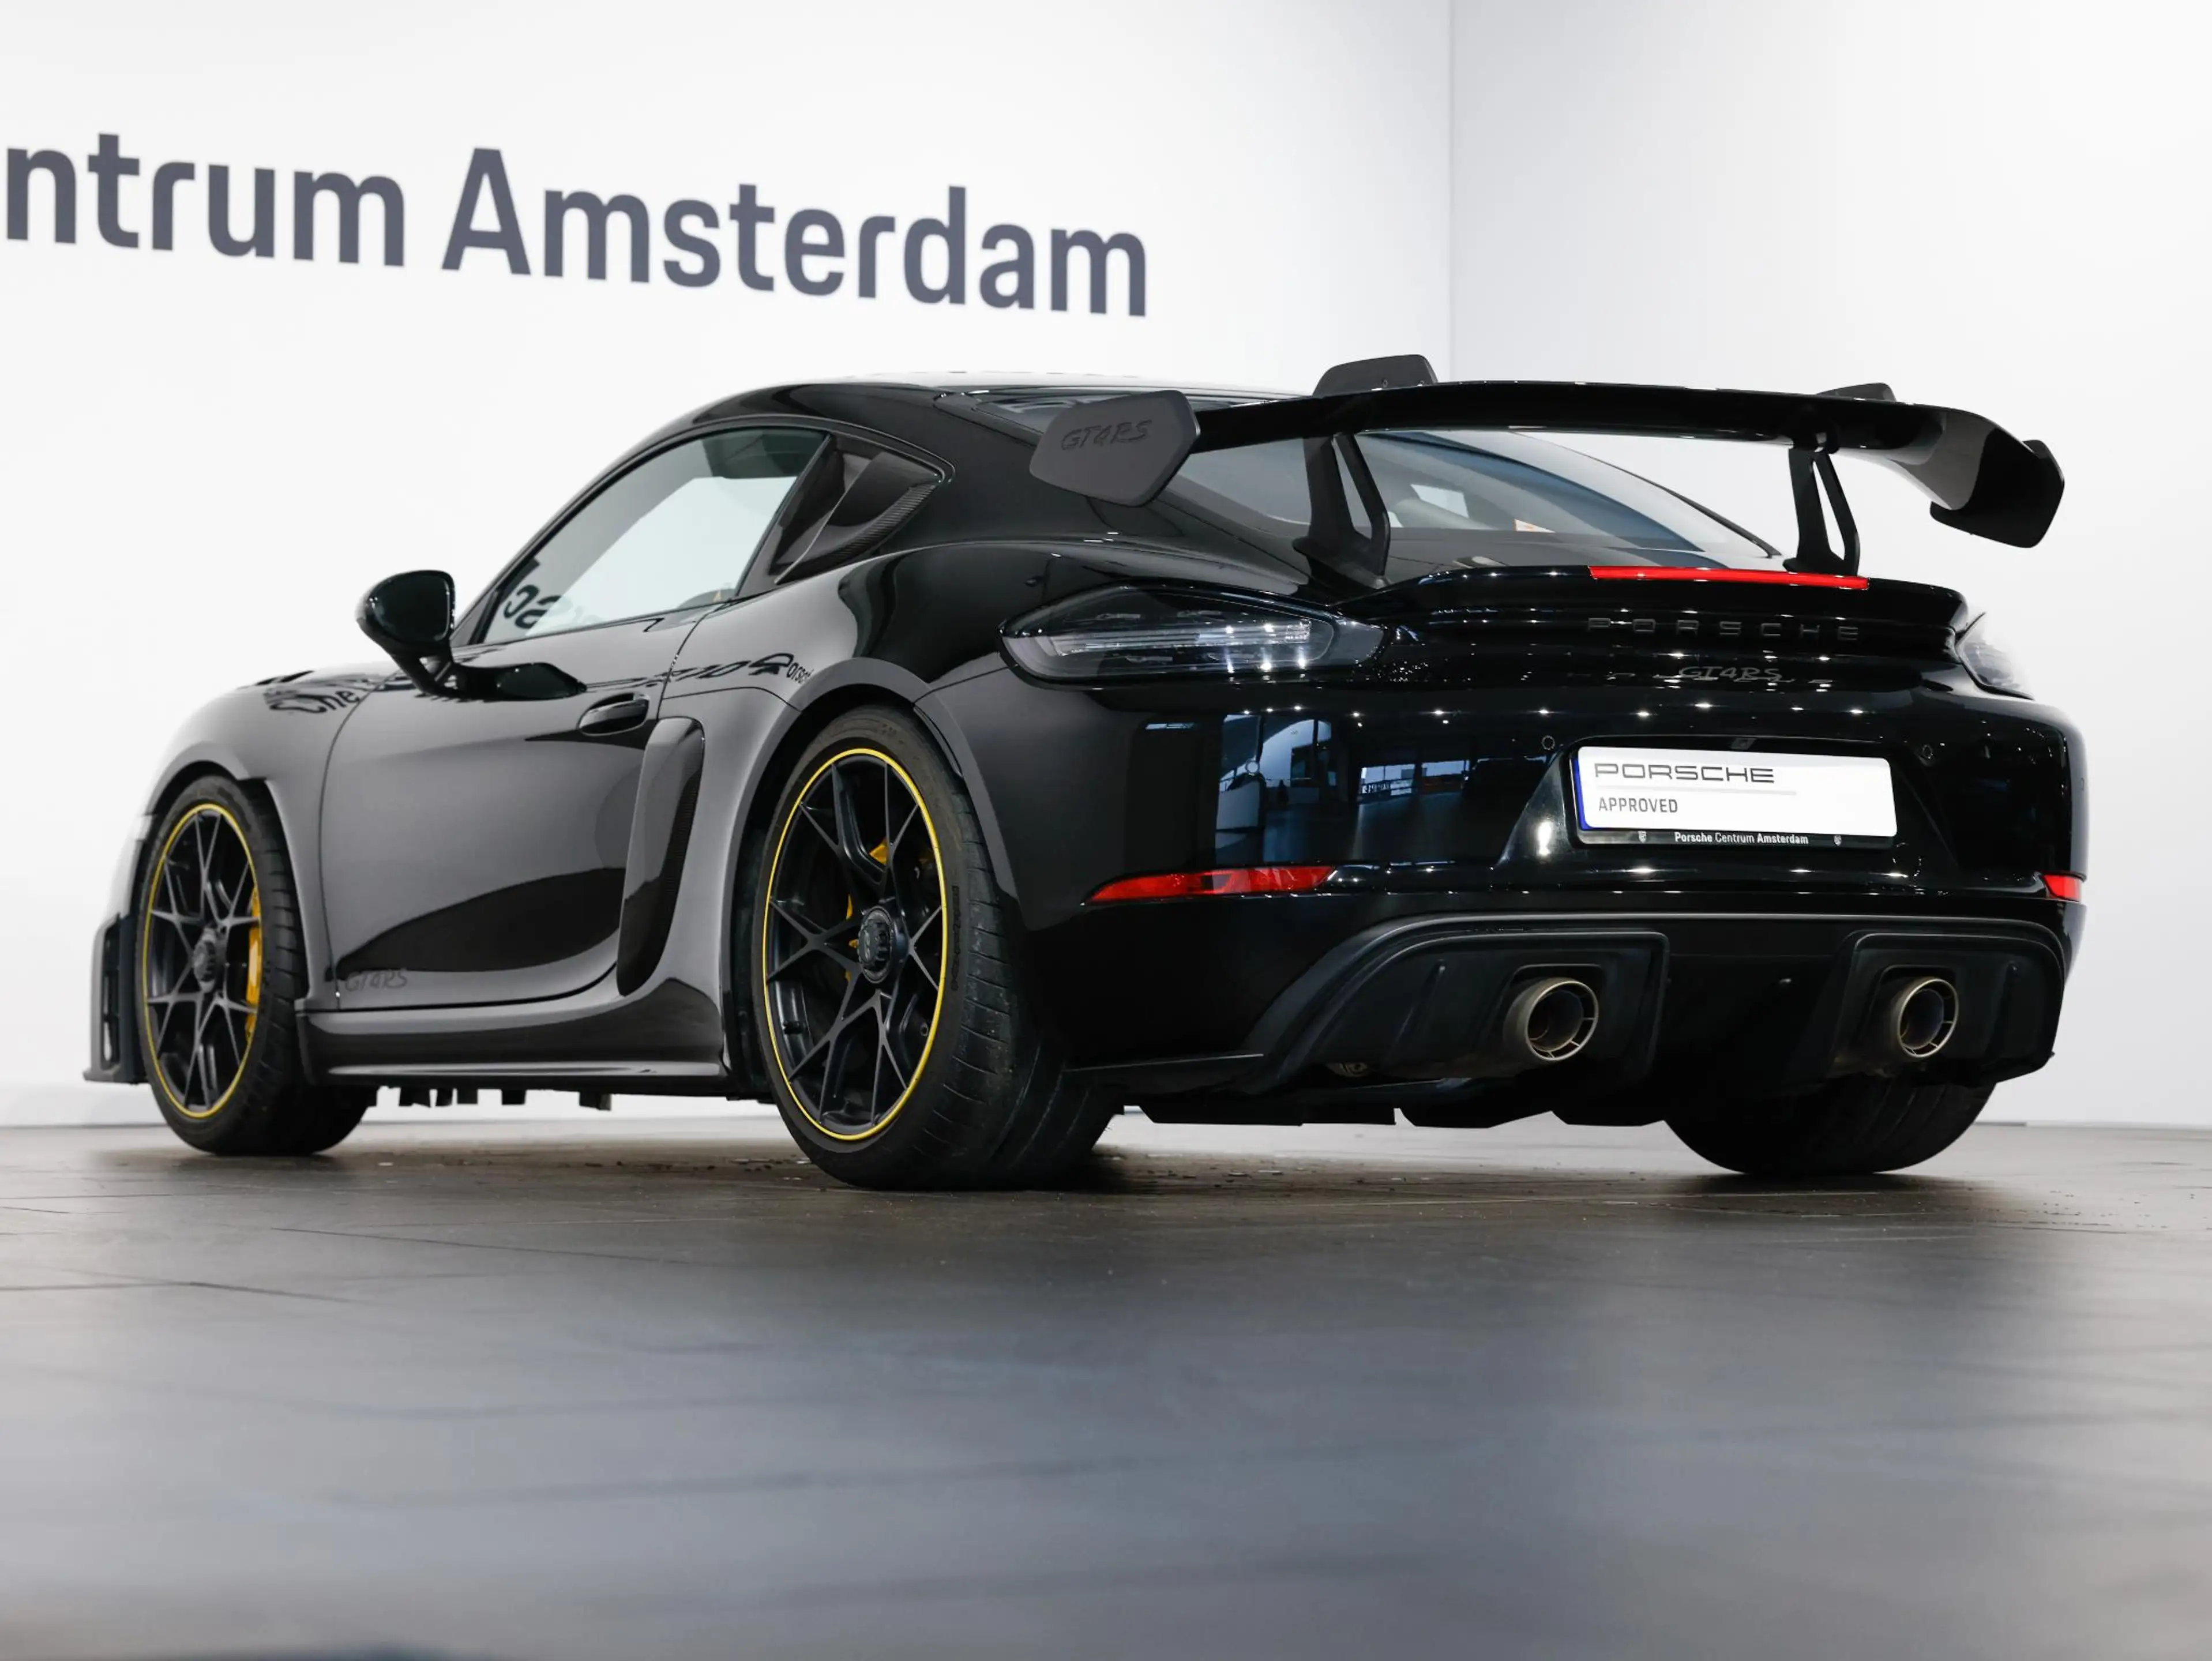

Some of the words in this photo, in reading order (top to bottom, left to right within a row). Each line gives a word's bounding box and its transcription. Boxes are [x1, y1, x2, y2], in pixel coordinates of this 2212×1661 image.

[7, 134, 404, 266] ntrum
[442, 148, 1145, 316] Amsterdam
[1588, 618, 1858, 641] PORSCHE
[1595, 764, 1774, 783] PORSCHE
[1599, 798, 1677, 813] APPROVED
[1674, 831, 1712, 843] Porsche
[1715, 832, 1755, 844] Centrum
[1757, 833, 1809, 845] Amsterdam
